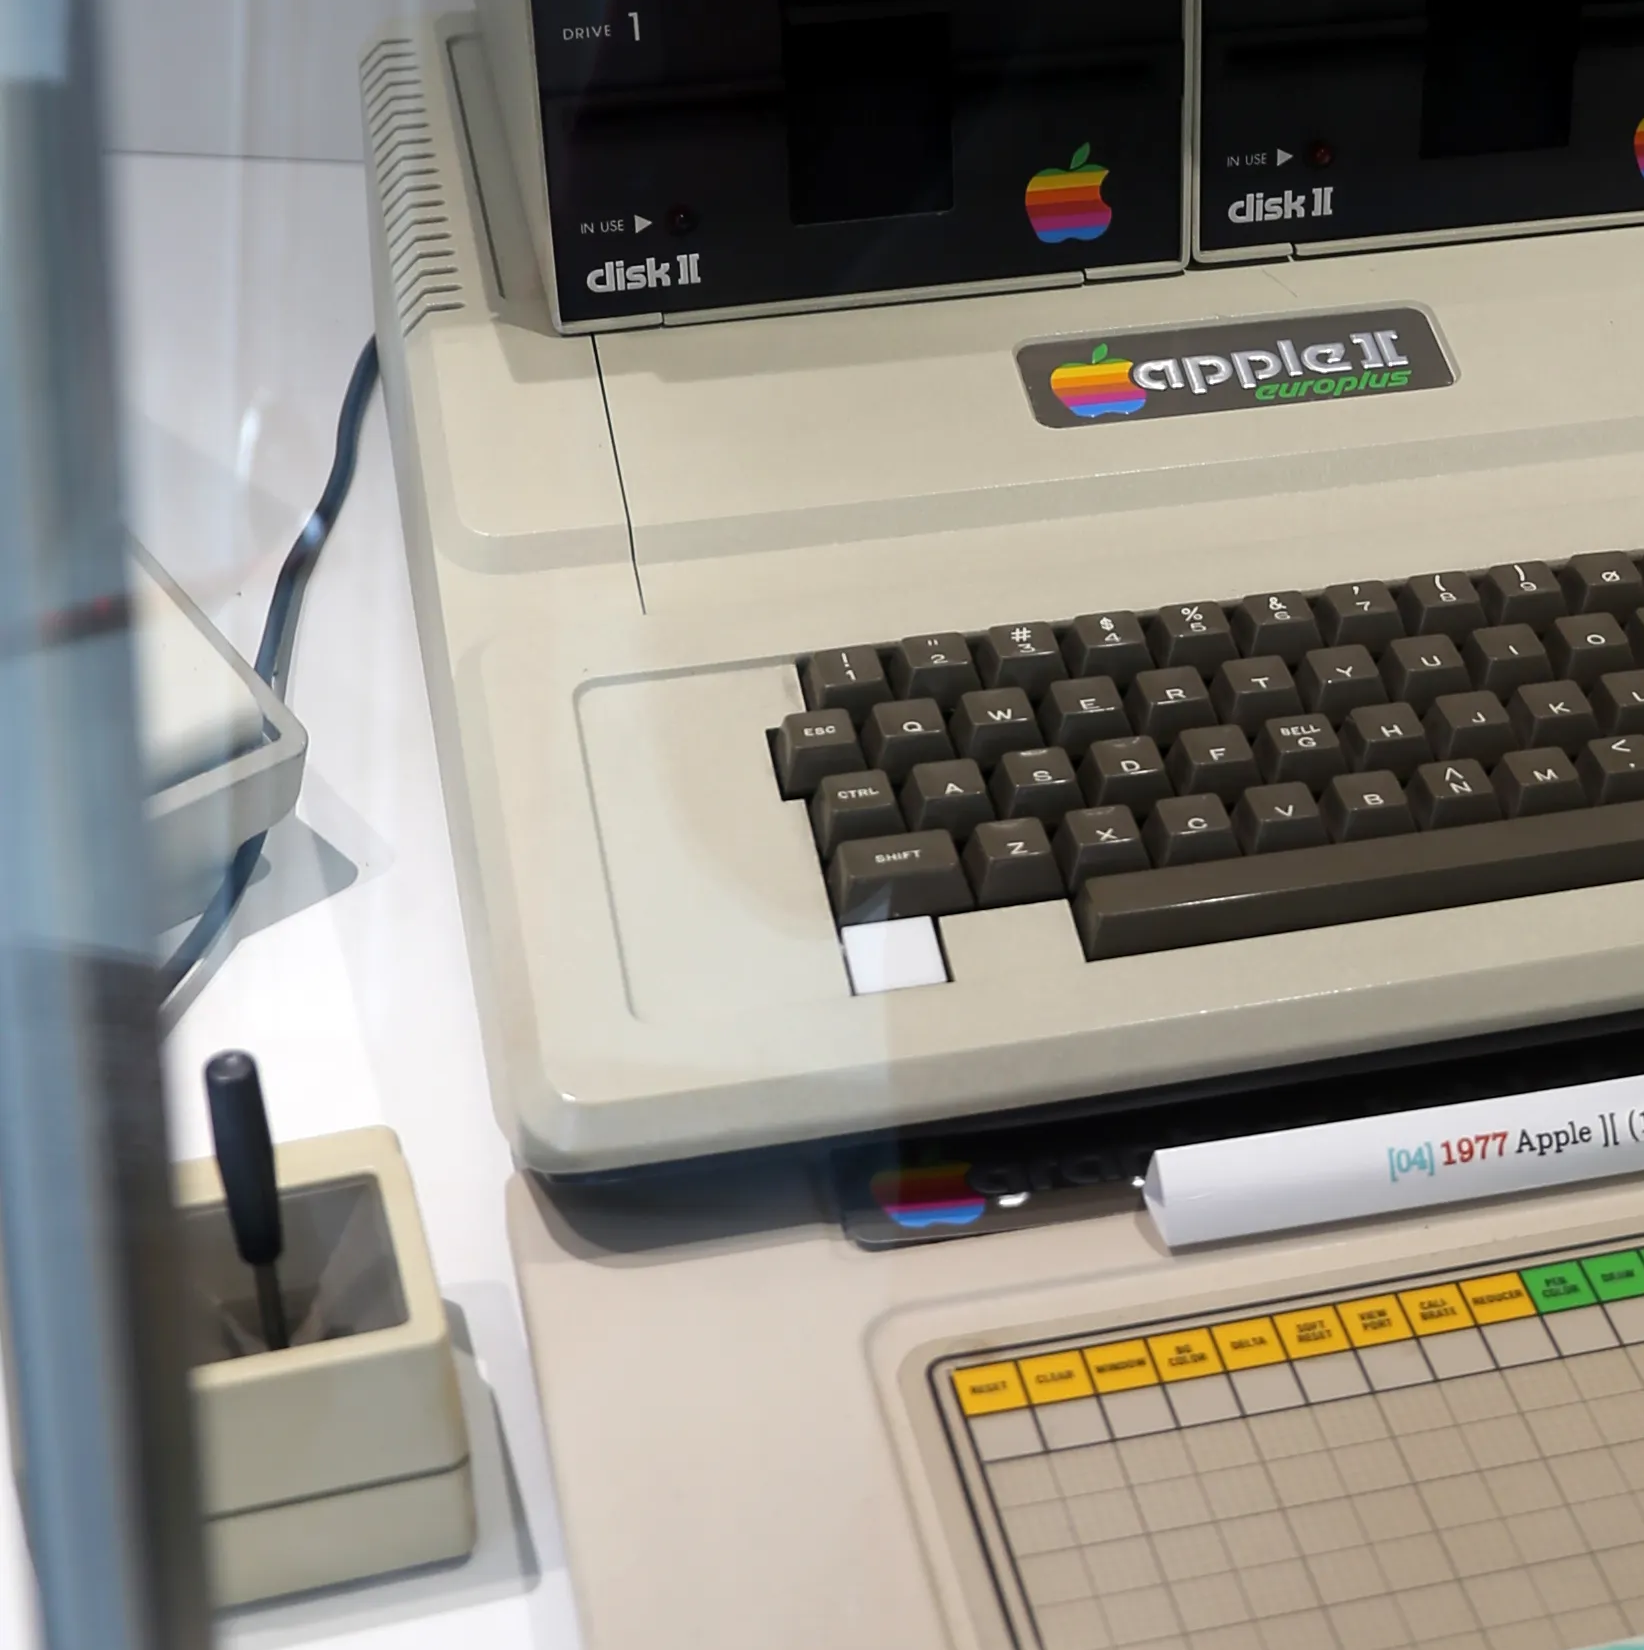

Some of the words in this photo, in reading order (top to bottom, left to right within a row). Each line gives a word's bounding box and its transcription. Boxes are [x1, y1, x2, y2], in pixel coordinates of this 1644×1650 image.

[562, 24, 612, 40] DRIVE
[628, 12, 641, 41] 1
[1227, 156, 1240, 167] IN
[1245, 153, 1267, 166] USE
[1228, 189, 1306, 224] disk
[580, 222, 594, 234] IN
[600, 219, 624, 233] USE
[586, 257, 671, 293] disk
[1132, 338, 1352, 395] apple
[1254, 368, 1413, 401] europlus
[803, 725, 836, 737] ESC
[903, 721, 923, 732] Q
[988, 708, 1013, 721] W
[1079, 697, 1097, 711] E
[1165, 688, 1187, 701] R
[1251, 676, 1270, 689] T
[1335, 665, 1354, 678] Y
[1421, 654, 1442, 667] U
[1280, 724, 1321, 737] BELL
[837, 786, 880, 800] CTRL
[945, 782, 964, 795] A
[1033, 770, 1052, 783] S
[1120, 759, 1141, 773] D
[1209, 747, 1227, 761] F
[1297, 736, 1317, 749] G
[1380, 724, 1404, 738] H
[1549, 701, 1571, 715] K
[875, 848, 922, 864] SHIFT
[1007, 841, 1029, 855] Z
[1096, 827, 1118, 842] X
[1187, 817, 1208, 830] C
[1274, 805, 1294, 817] V
[1363, 793, 1385, 806] B
[1450, 780, 1473, 794] N
[1533, 767, 1560, 782] M
[1387, 1140, 1436, 1182] [04]
[1440, 1130, 1510, 1166] 1977
[1515, 1120, 1592, 1156] Apple
